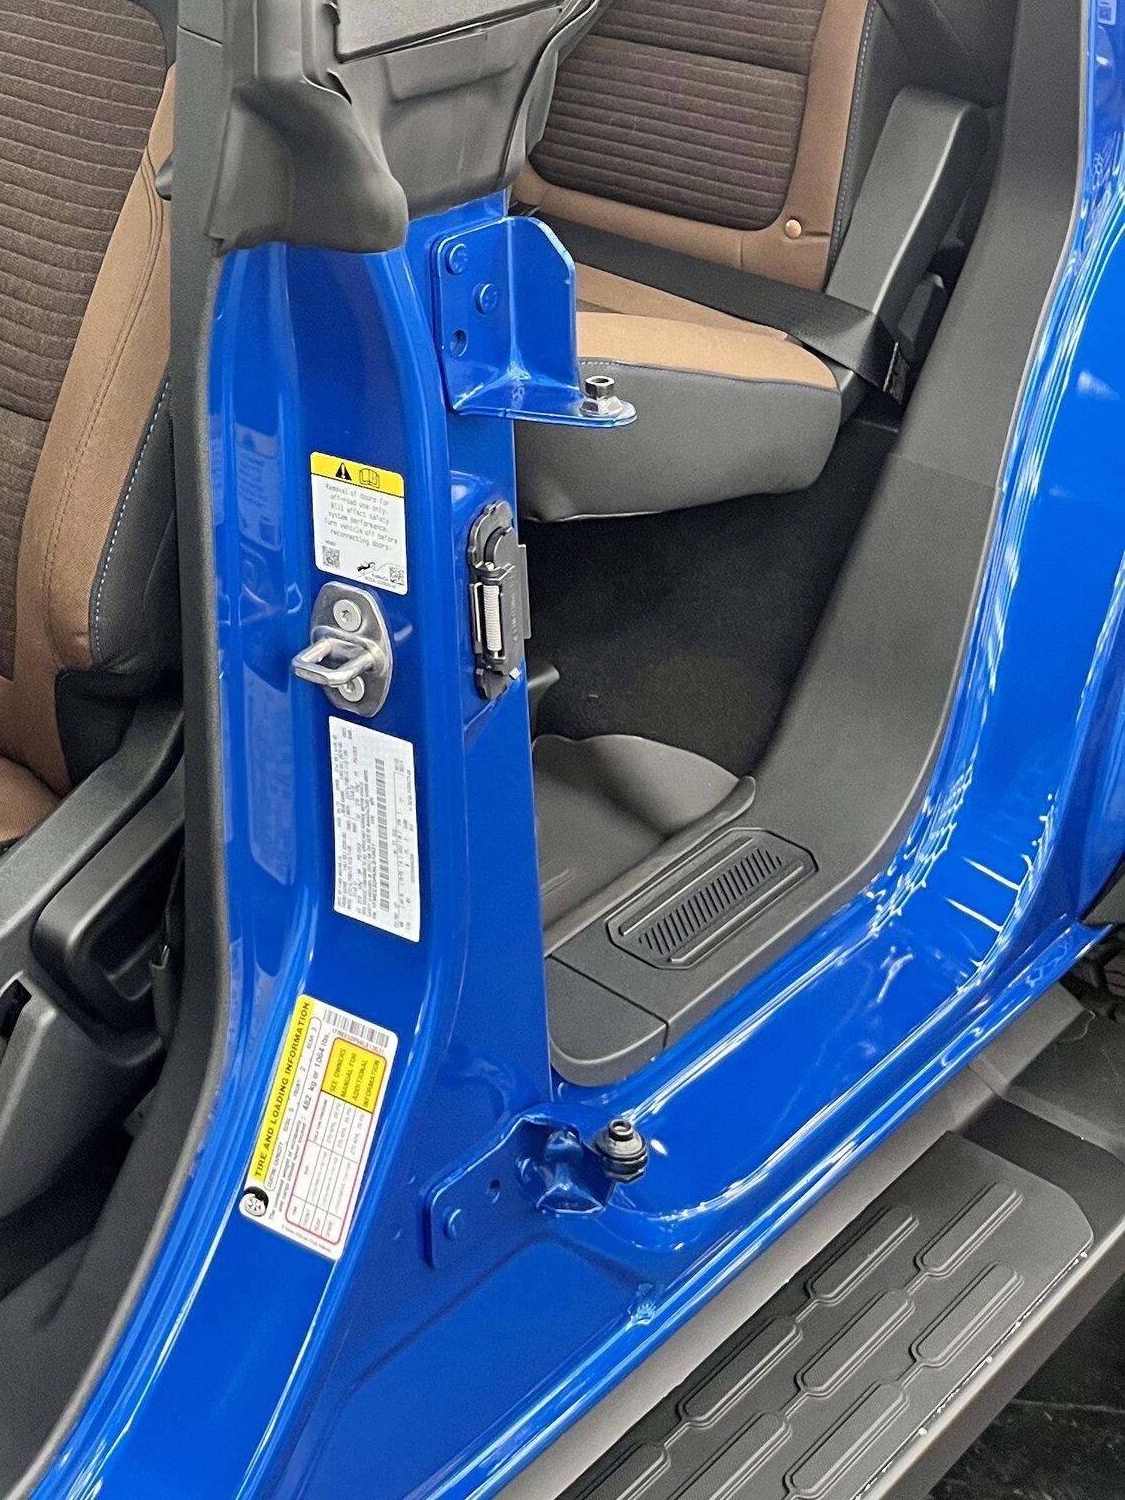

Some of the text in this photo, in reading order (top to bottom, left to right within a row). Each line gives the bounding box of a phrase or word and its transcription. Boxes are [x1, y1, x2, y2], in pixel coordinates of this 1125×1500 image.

[254, 1001, 310, 1177] TIRE AND LOADING INFORMATION
[301, 1030, 330, 1111] 482 kg or 1064 lbs.
[340, 1052, 357, 1098] MANUAL FOR
[353, 1058, 368, 1101] ADDITIONAL
